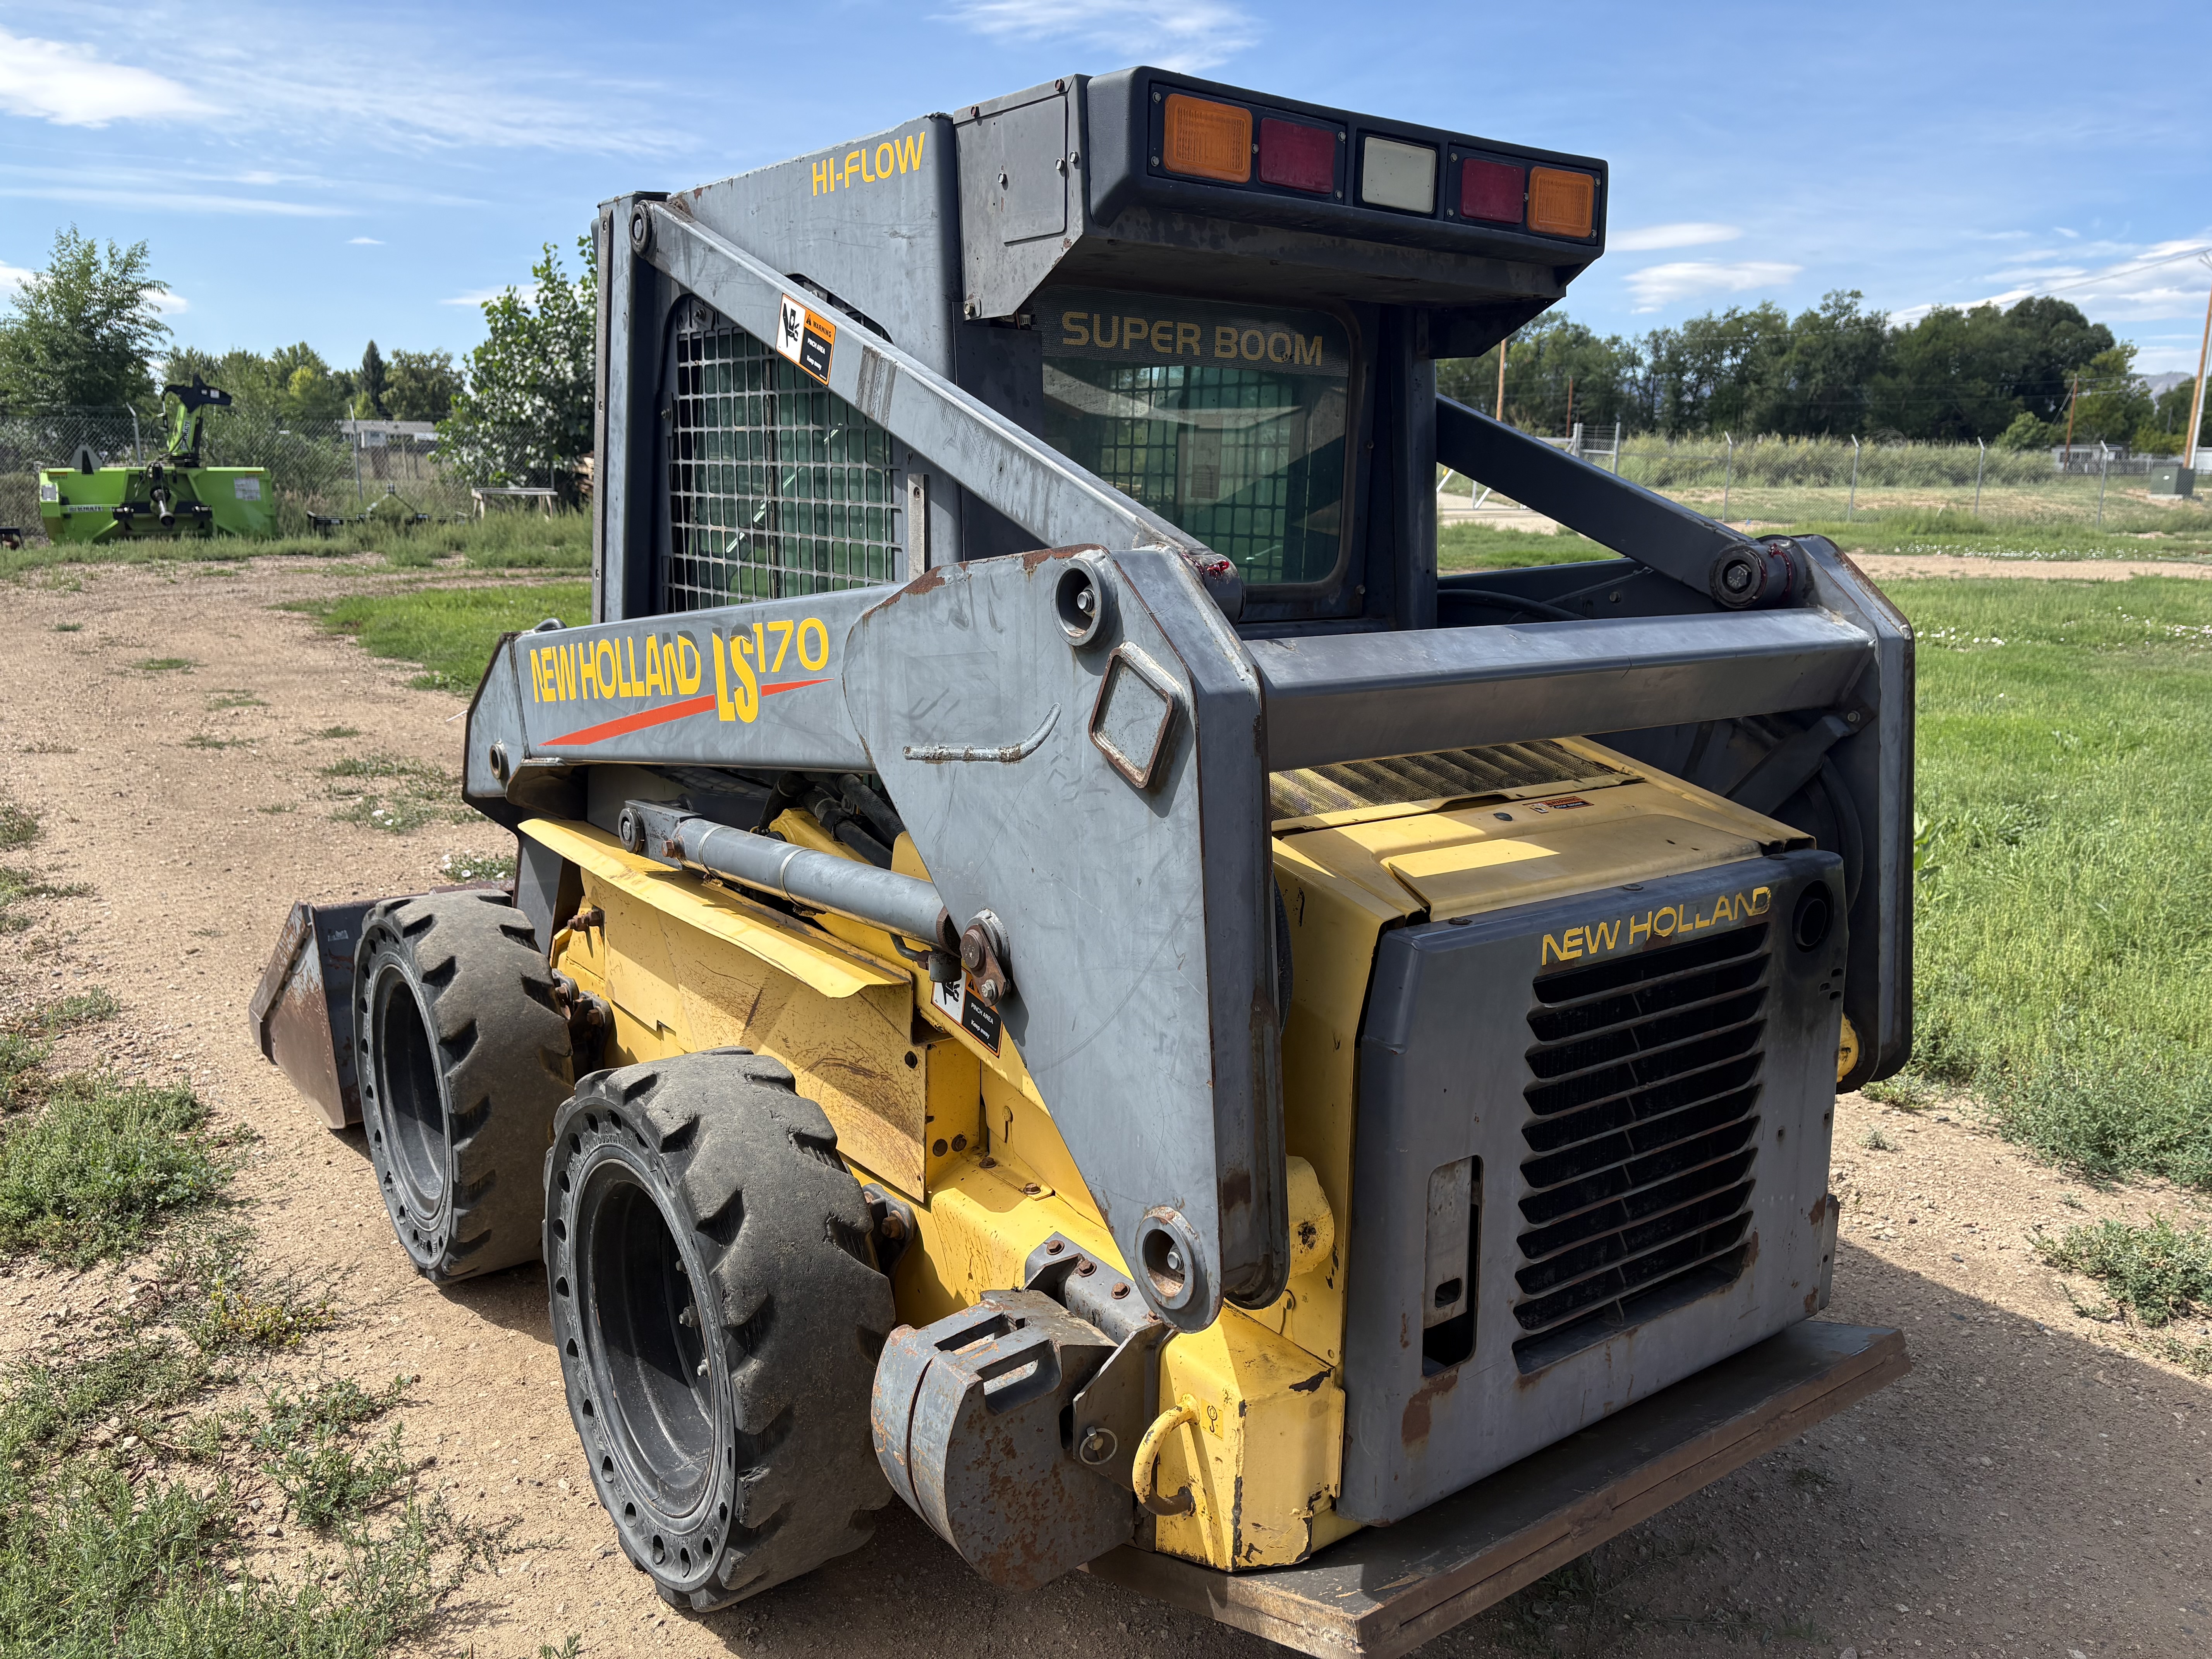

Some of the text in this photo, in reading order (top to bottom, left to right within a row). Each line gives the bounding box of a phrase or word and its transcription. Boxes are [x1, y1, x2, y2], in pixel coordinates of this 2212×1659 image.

[812, 132, 925, 196] HI-FLOW
[807, 338, 825, 354] PINCH AREA
[813, 321, 831, 338] WARNING
[1062, 311, 1322, 366] SUPER BOOM
[530, 643, 577, 702] NEW
[578, 631, 701, 699] HOLLAND
[1542, 886, 1771, 965] NEW HOLLAND
[971, 1002, 994, 1024] PINCH AREA
[971, 1019, 990, 1039] Keep away
